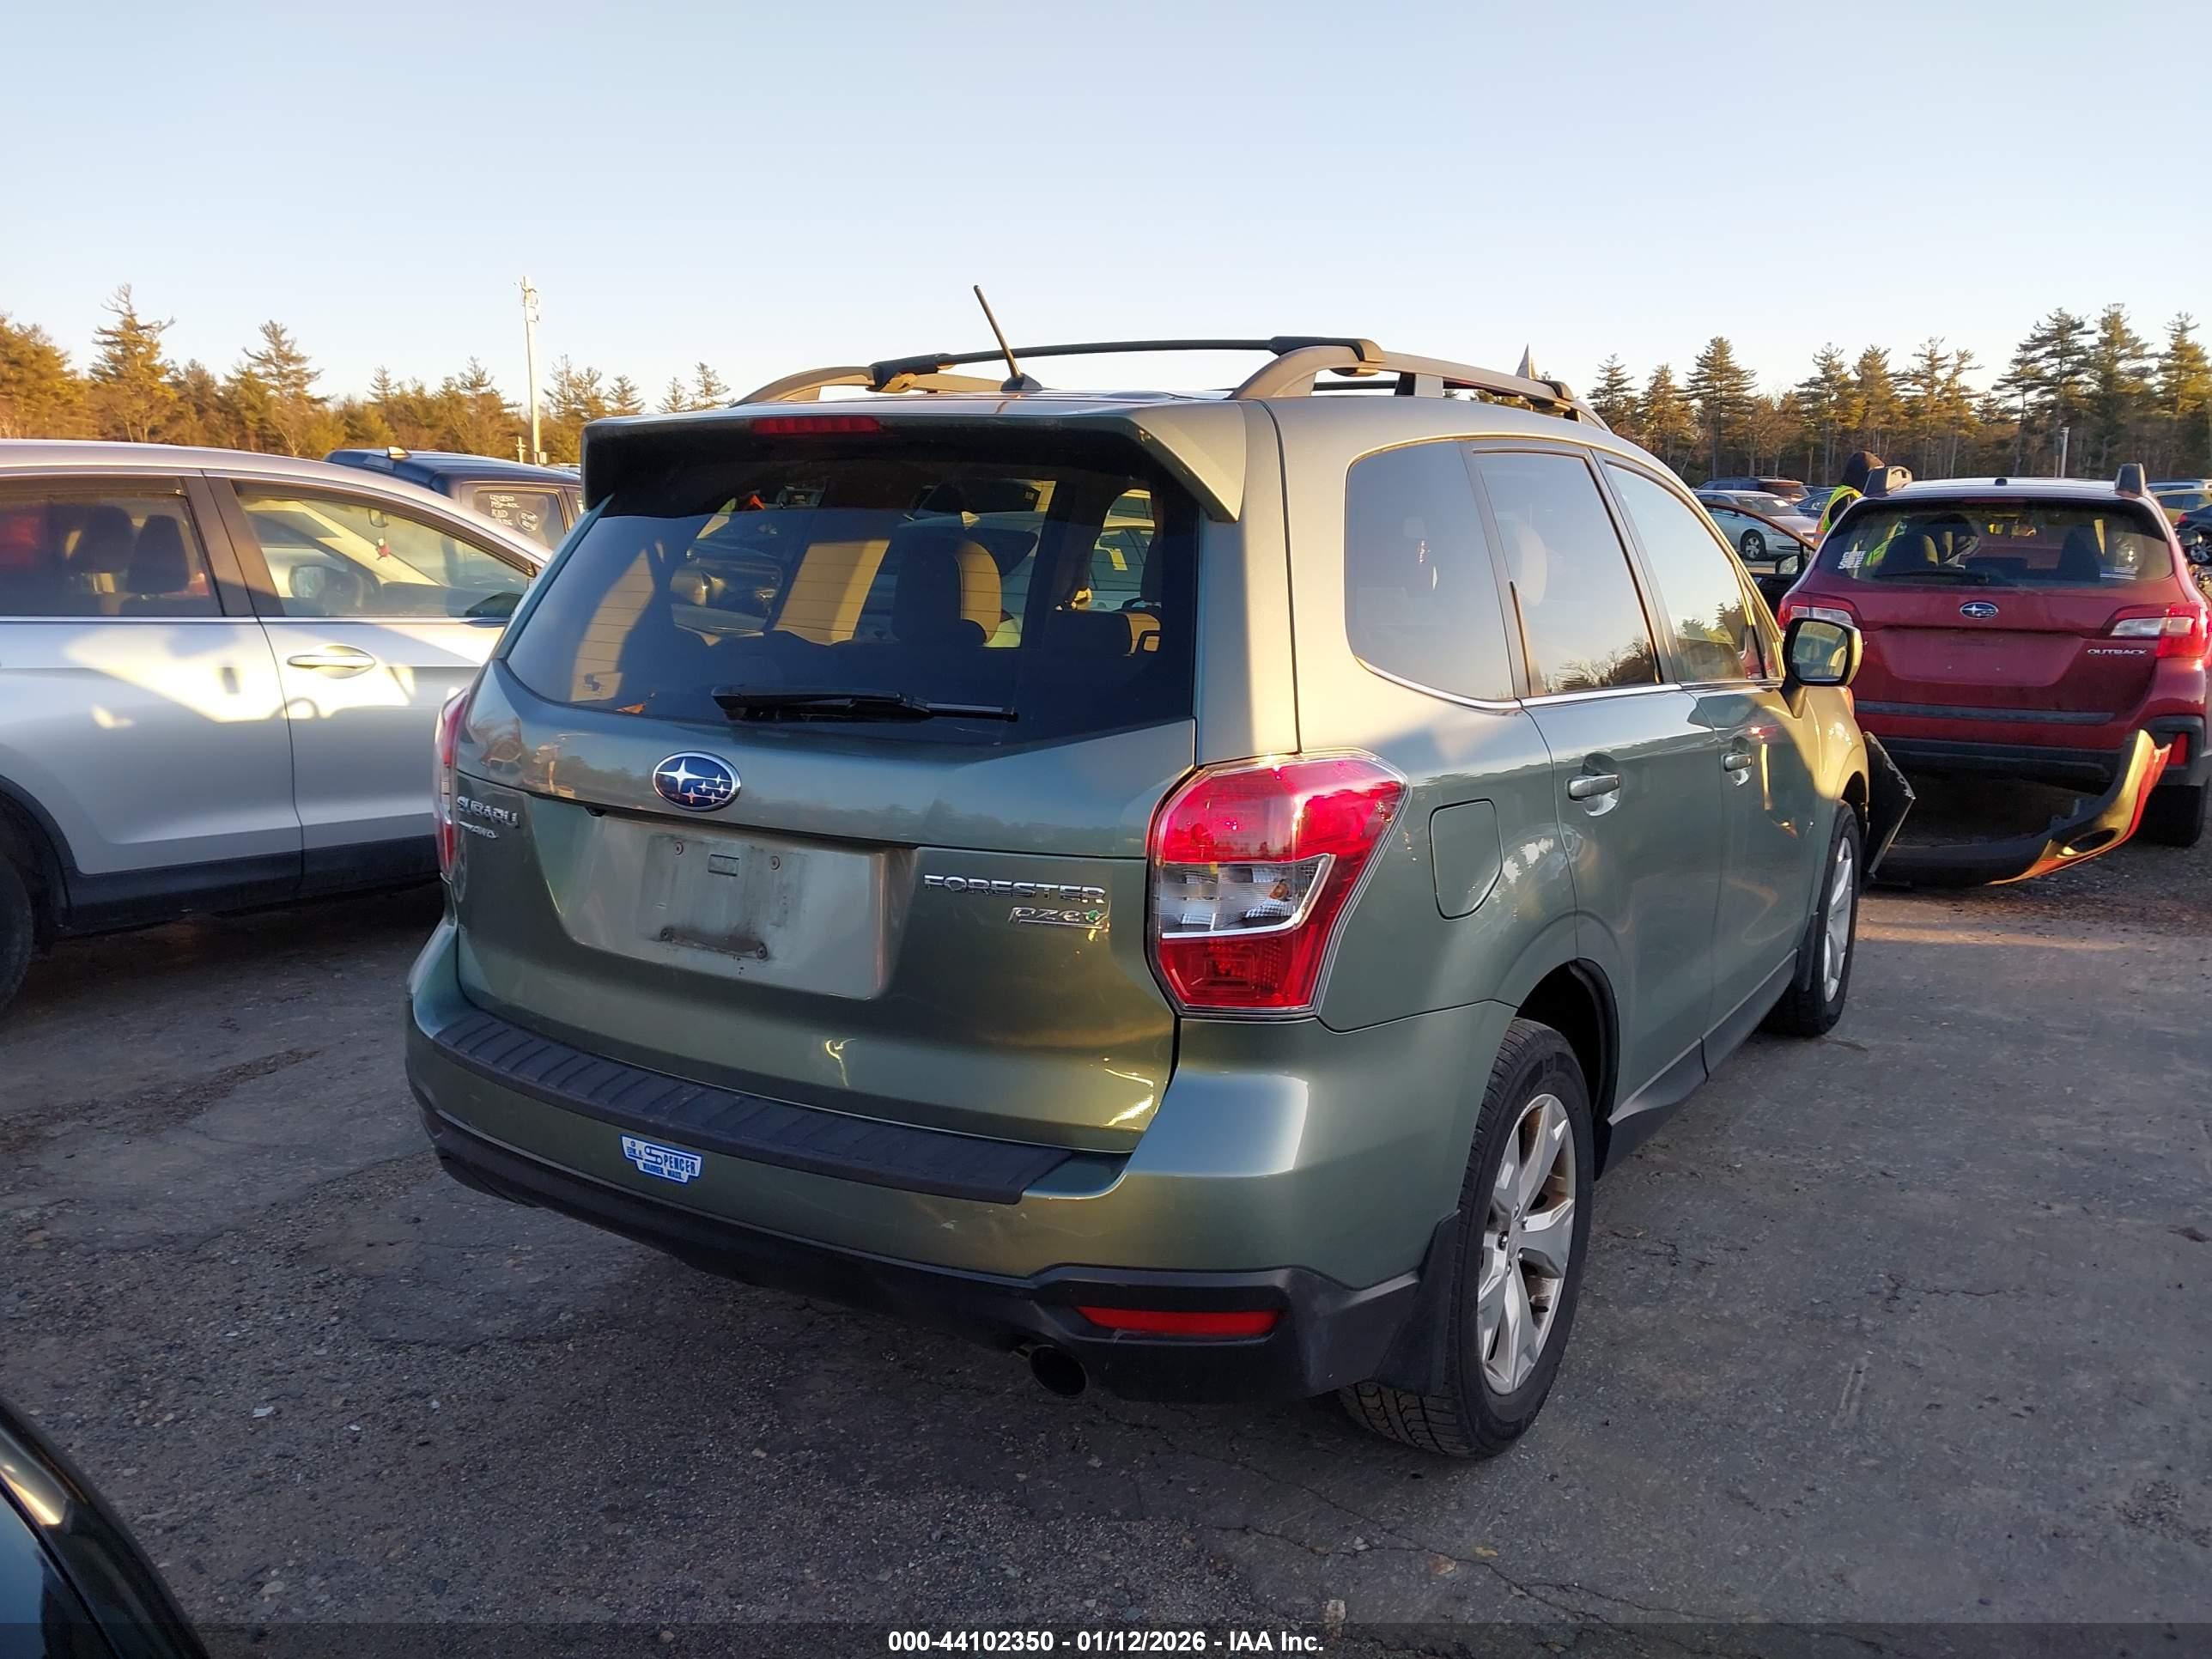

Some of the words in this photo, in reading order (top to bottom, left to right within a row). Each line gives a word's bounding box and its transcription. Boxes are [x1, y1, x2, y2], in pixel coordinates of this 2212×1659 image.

[457, 796, 519, 826] SUBARU
[924, 874, 1107, 903] FORESTER
[644, 1145, 696, 1174] SPENCER
